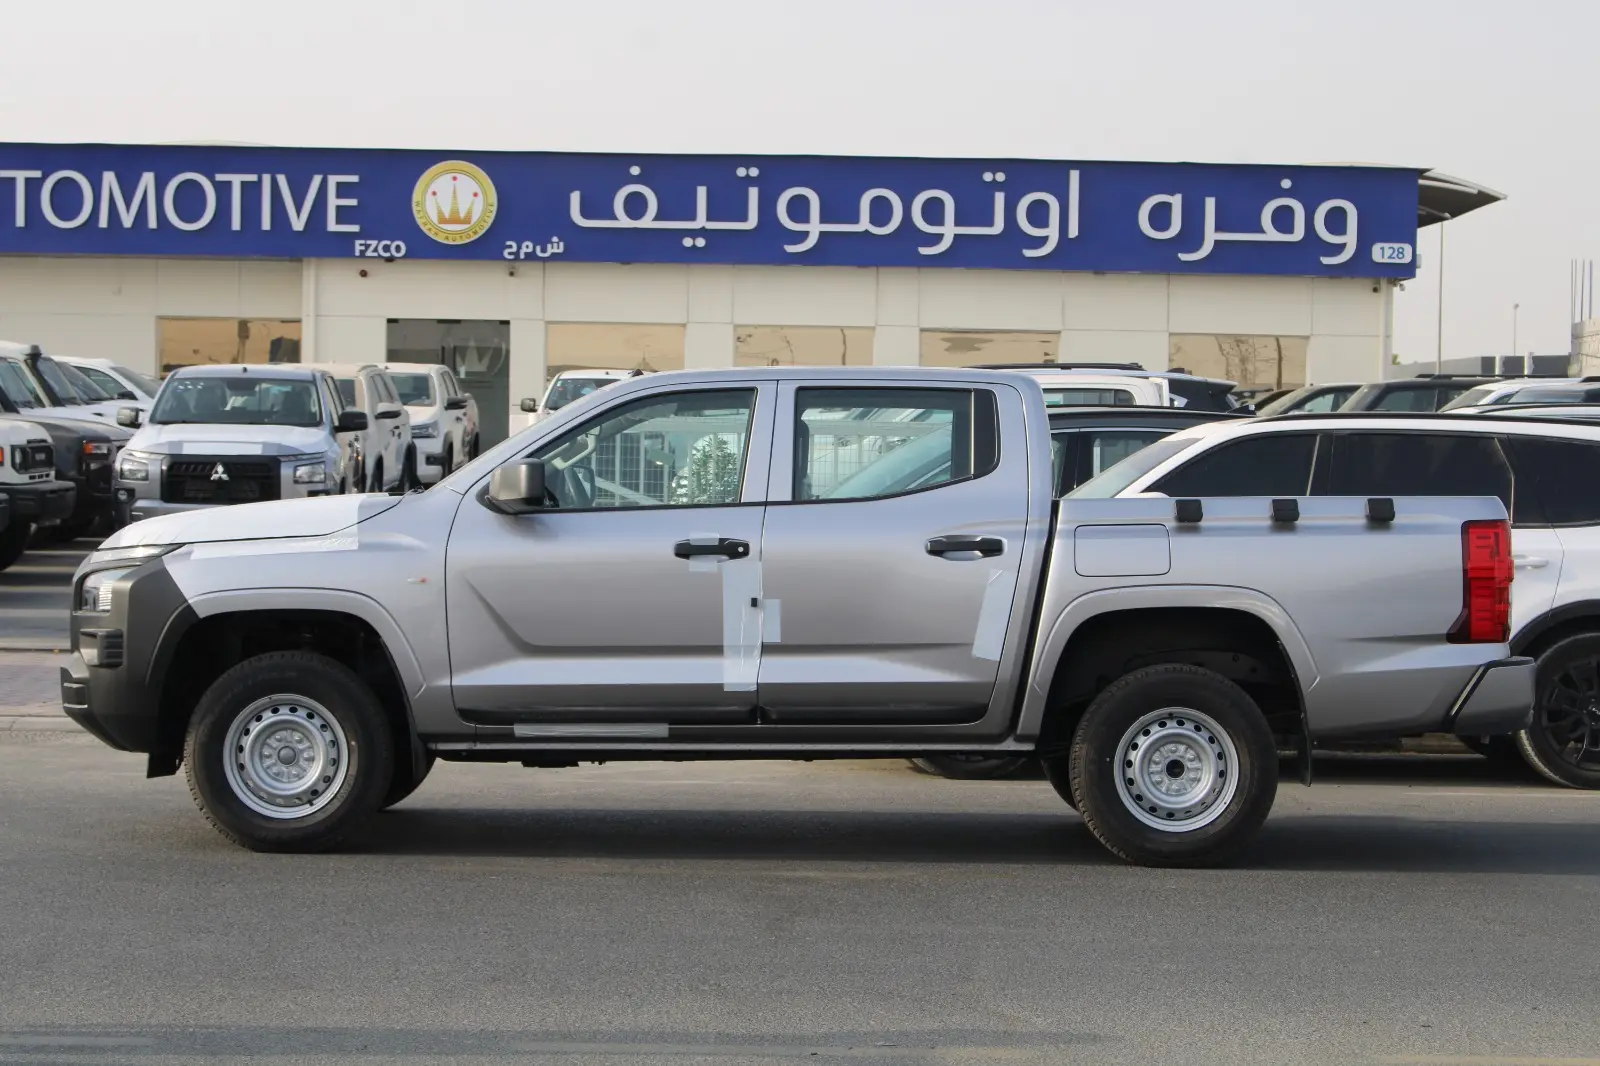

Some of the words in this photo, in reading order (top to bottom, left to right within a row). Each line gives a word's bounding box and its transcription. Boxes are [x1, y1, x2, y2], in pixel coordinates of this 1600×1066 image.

[0, 169, 361, 233] TOMOTIVE
[569, 165, 1080, 259] اوتوموتيف
[1137, 178, 1358, 265] وفره
[354, 239, 407, 258] FZCO
[1380, 246, 1405, 260] 128
